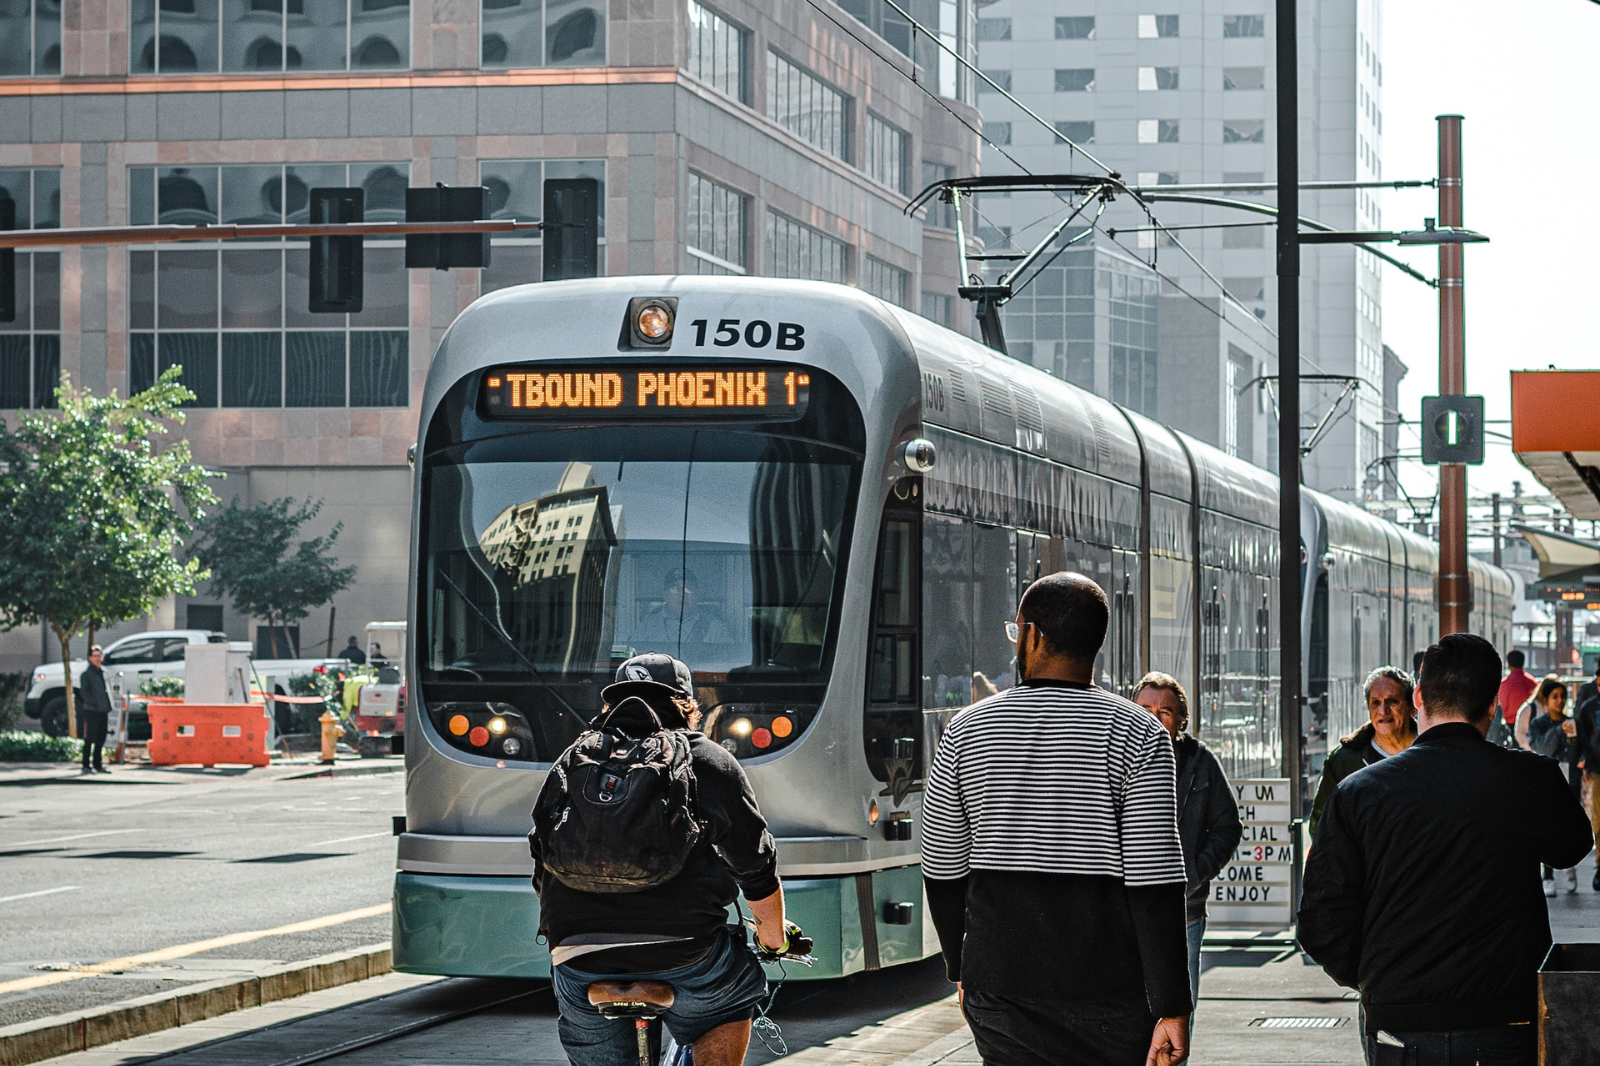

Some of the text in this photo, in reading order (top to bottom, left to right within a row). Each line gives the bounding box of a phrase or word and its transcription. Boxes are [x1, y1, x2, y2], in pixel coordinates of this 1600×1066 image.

[690, 319, 806, 351] 150B
[506, 373, 622, 407] TBOUND
[637, 372, 766, 407] PHOENIX
[923, 372, 945, 412] 150B
[1255, 785, 1275, 801] UM
[1215, 886, 1270, 901] ENJOY
